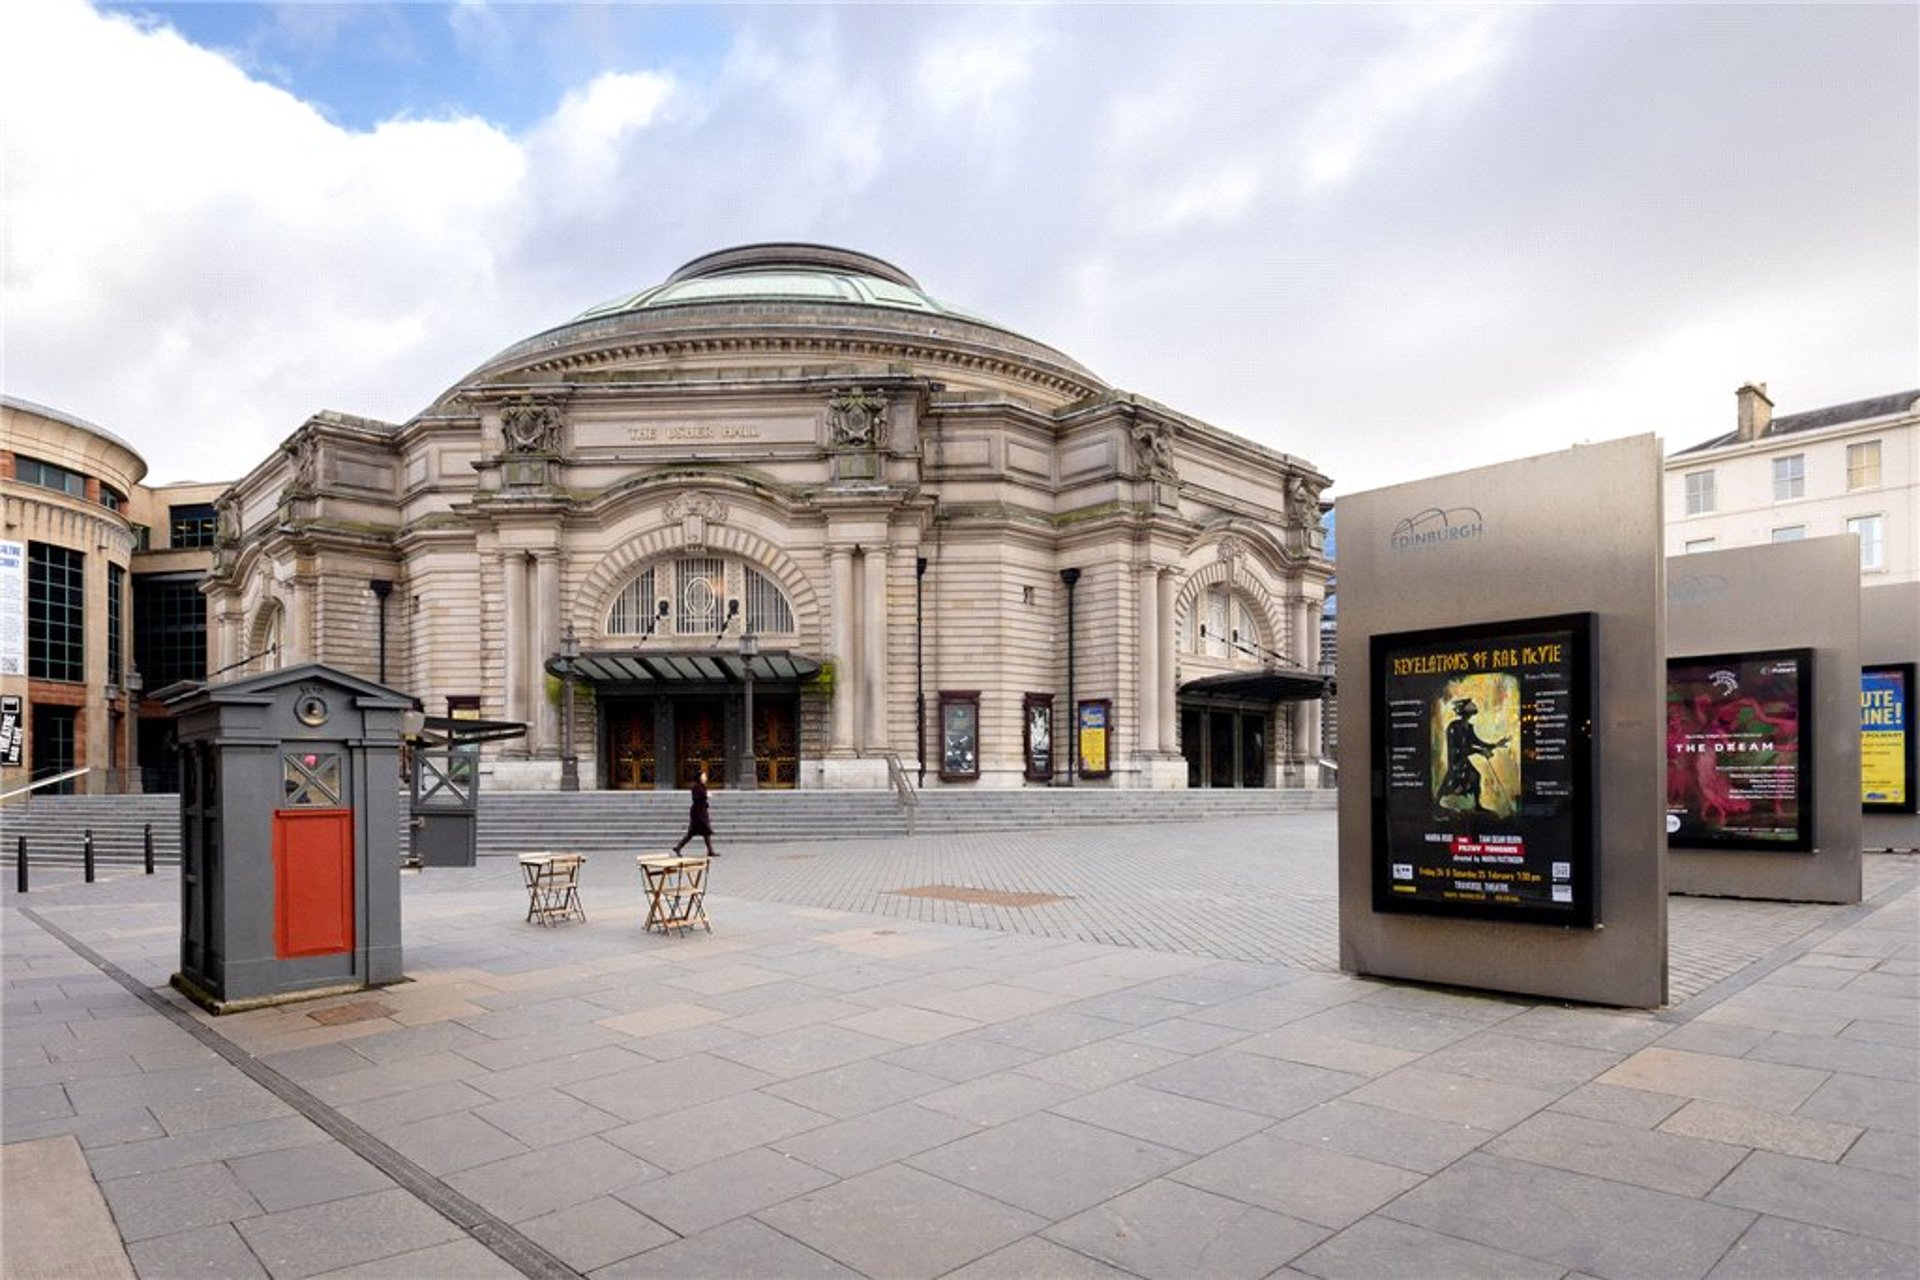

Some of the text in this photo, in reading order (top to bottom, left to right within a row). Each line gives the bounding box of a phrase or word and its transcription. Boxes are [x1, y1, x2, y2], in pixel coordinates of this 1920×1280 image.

[628, 426, 760, 441] THE USHER HALL
[1391, 523, 1482, 547] EDINBURGH
[1394, 652, 1469, 676] REVELATIONS
[1473, 651, 1487, 669] OF
[1493, 649, 1518, 669] RAB
[1861, 702, 1902, 725] INE!
[1675, 742, 1774, 753] THE DREAM
[1453, 868, 1476, 880] Saturday
[1488, 871, 1514, 881] February
